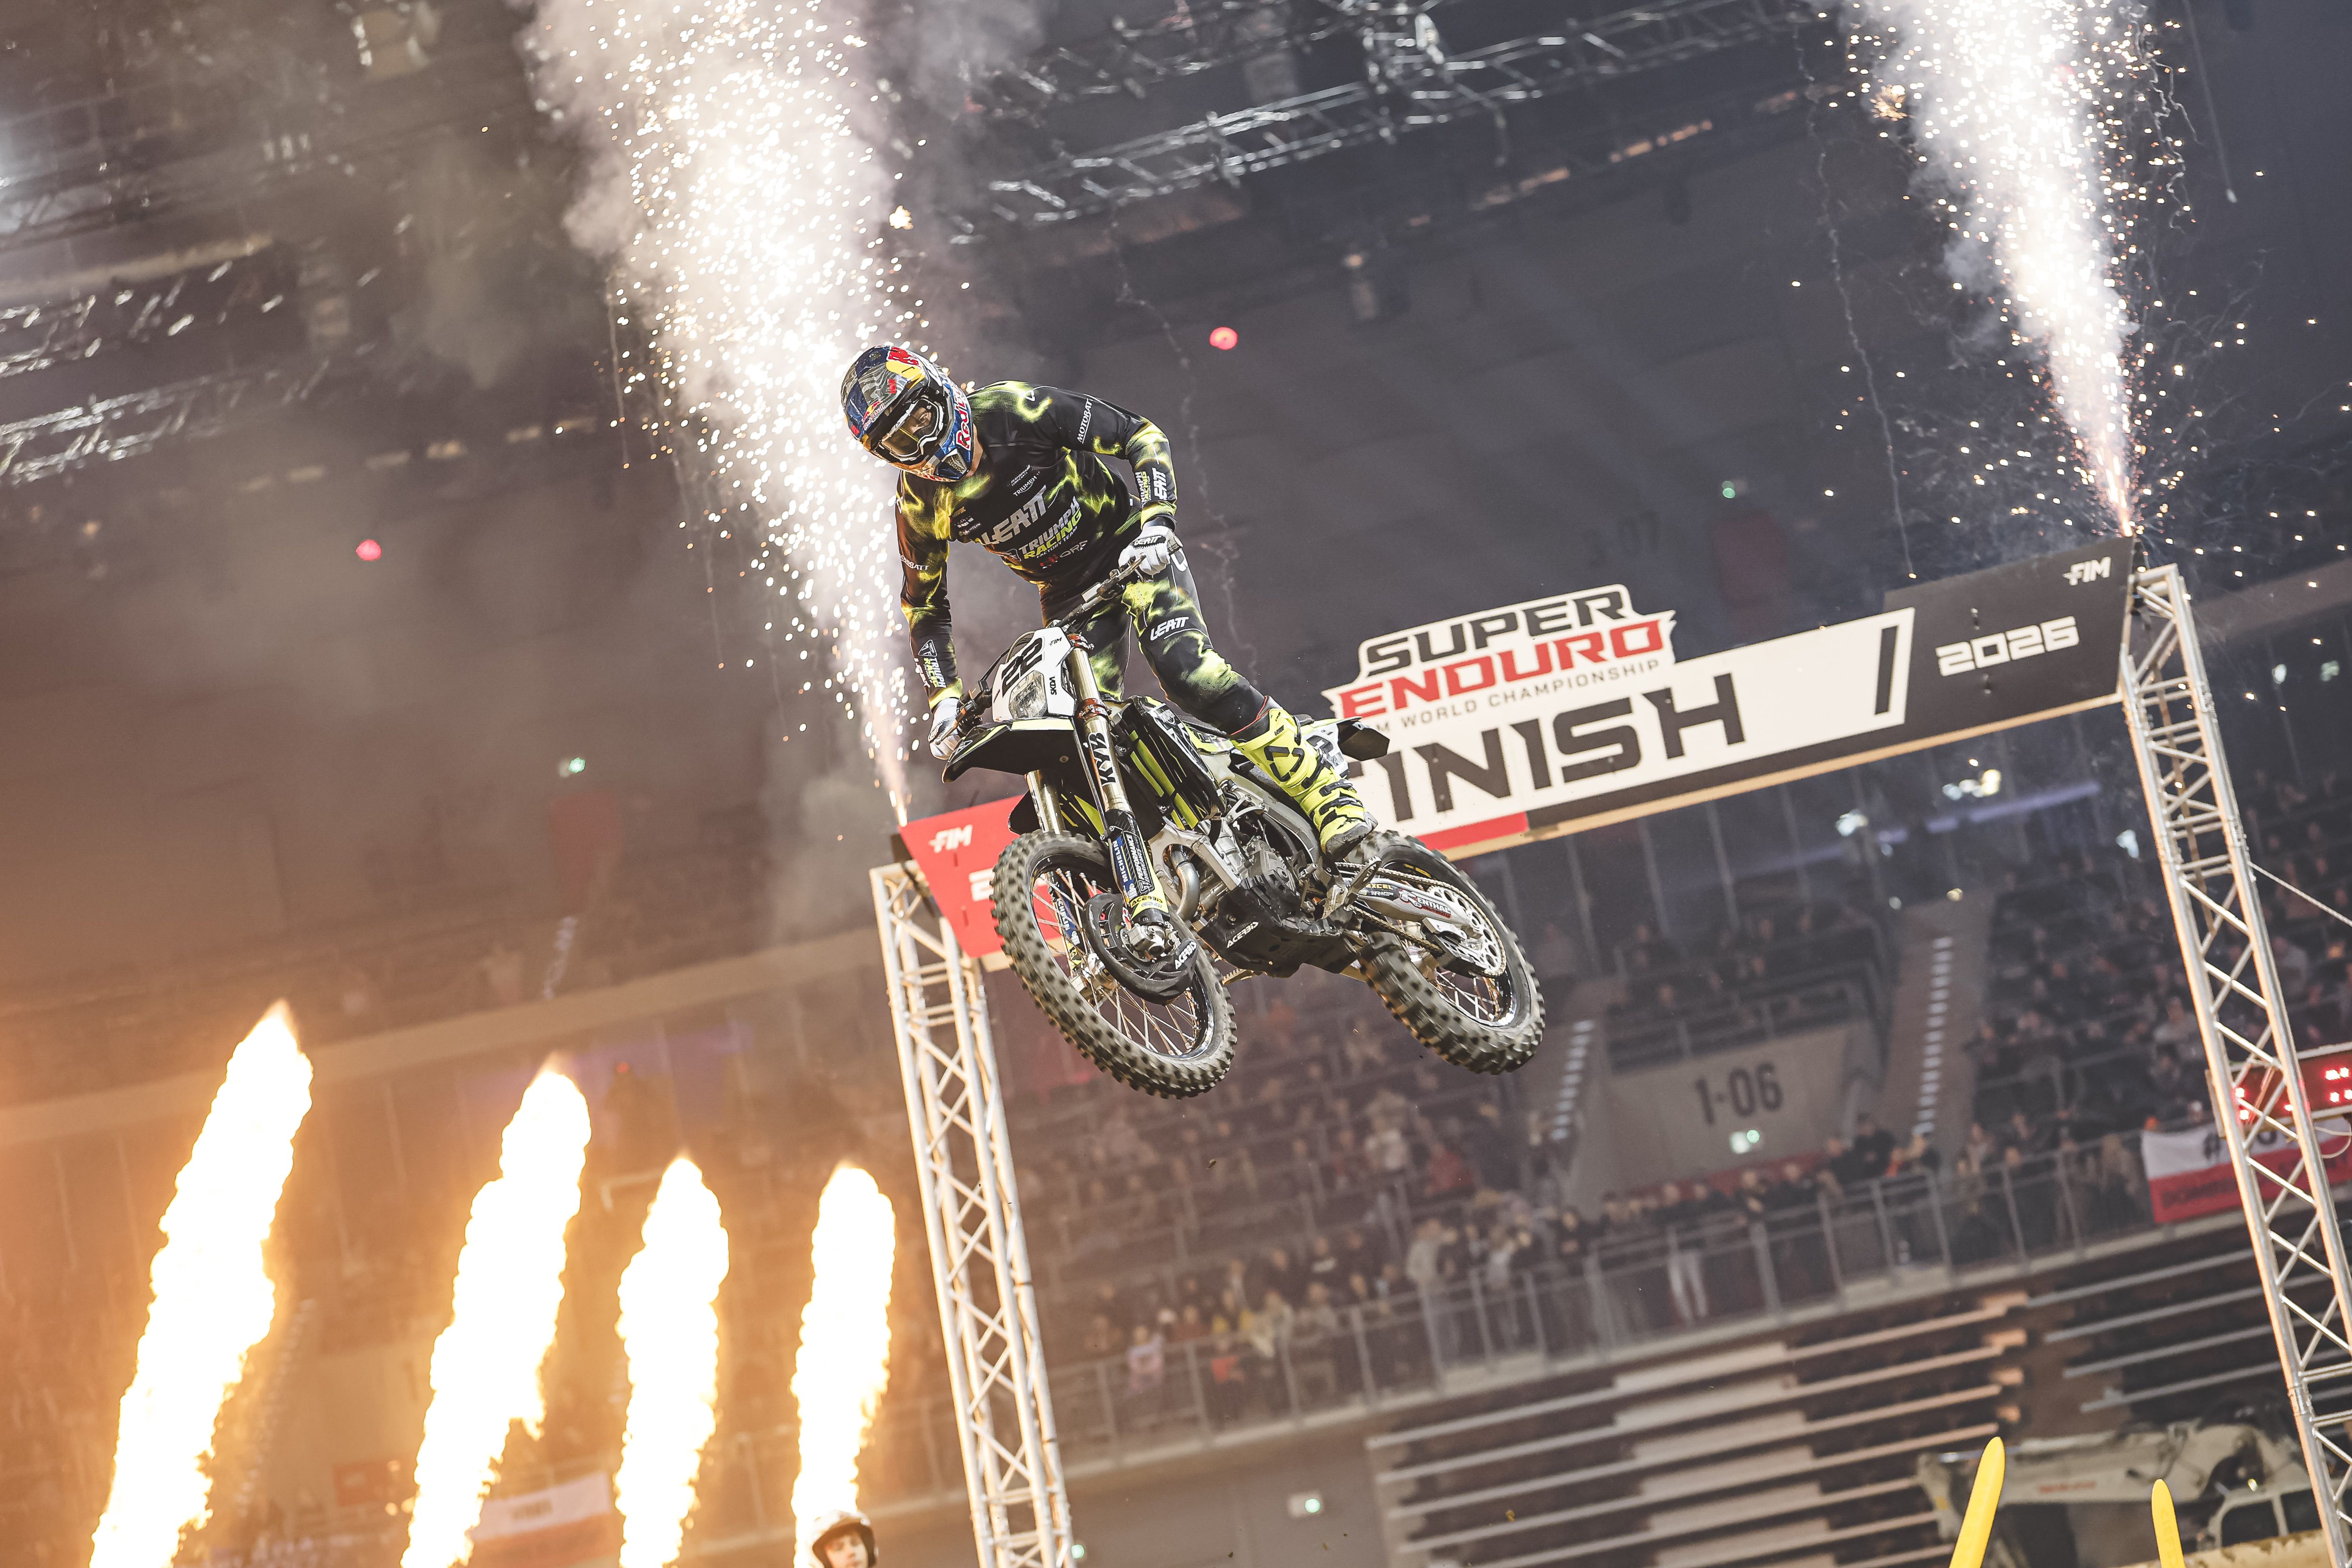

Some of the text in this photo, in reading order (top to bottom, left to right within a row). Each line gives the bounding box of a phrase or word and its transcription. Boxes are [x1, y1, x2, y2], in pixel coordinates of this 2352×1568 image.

[1013, 476, 1038, 497] TRIUMPH
[981, 484, 1047, 545] LEATT
[1018, 495, 1080, 555] TRIUMPH
[1023, 507, 1082, 559] RACING
[1036, 525, 1078, 559] FACTORY TEAM
[2062, 556, 2112, 586] FIM
[1049, 637, 1063, 646] FIM
[1150, 616, 1190, 641] LEATT
[1365, 590, 1625, 677] SUPER
[1935, 615, 2080, 677] 2026
[1339, 619, 1664, 719] ENDURO
[1401, 659, 1660, 729] WORLD CHAMPIONSHIP
[1089, 732, 1117, 787] KYB
[1348, 672, 1746, 823] INISH
[928, 824, 973, 853] FIM
[1112, 840, 1128, 883] MICHELIN
[1126, 834, 1144, 880] PERFORMANCE
[1175, 940, 1198, 970] ACERBIS
[1226, 920, 1261, 949] ACERBIS
